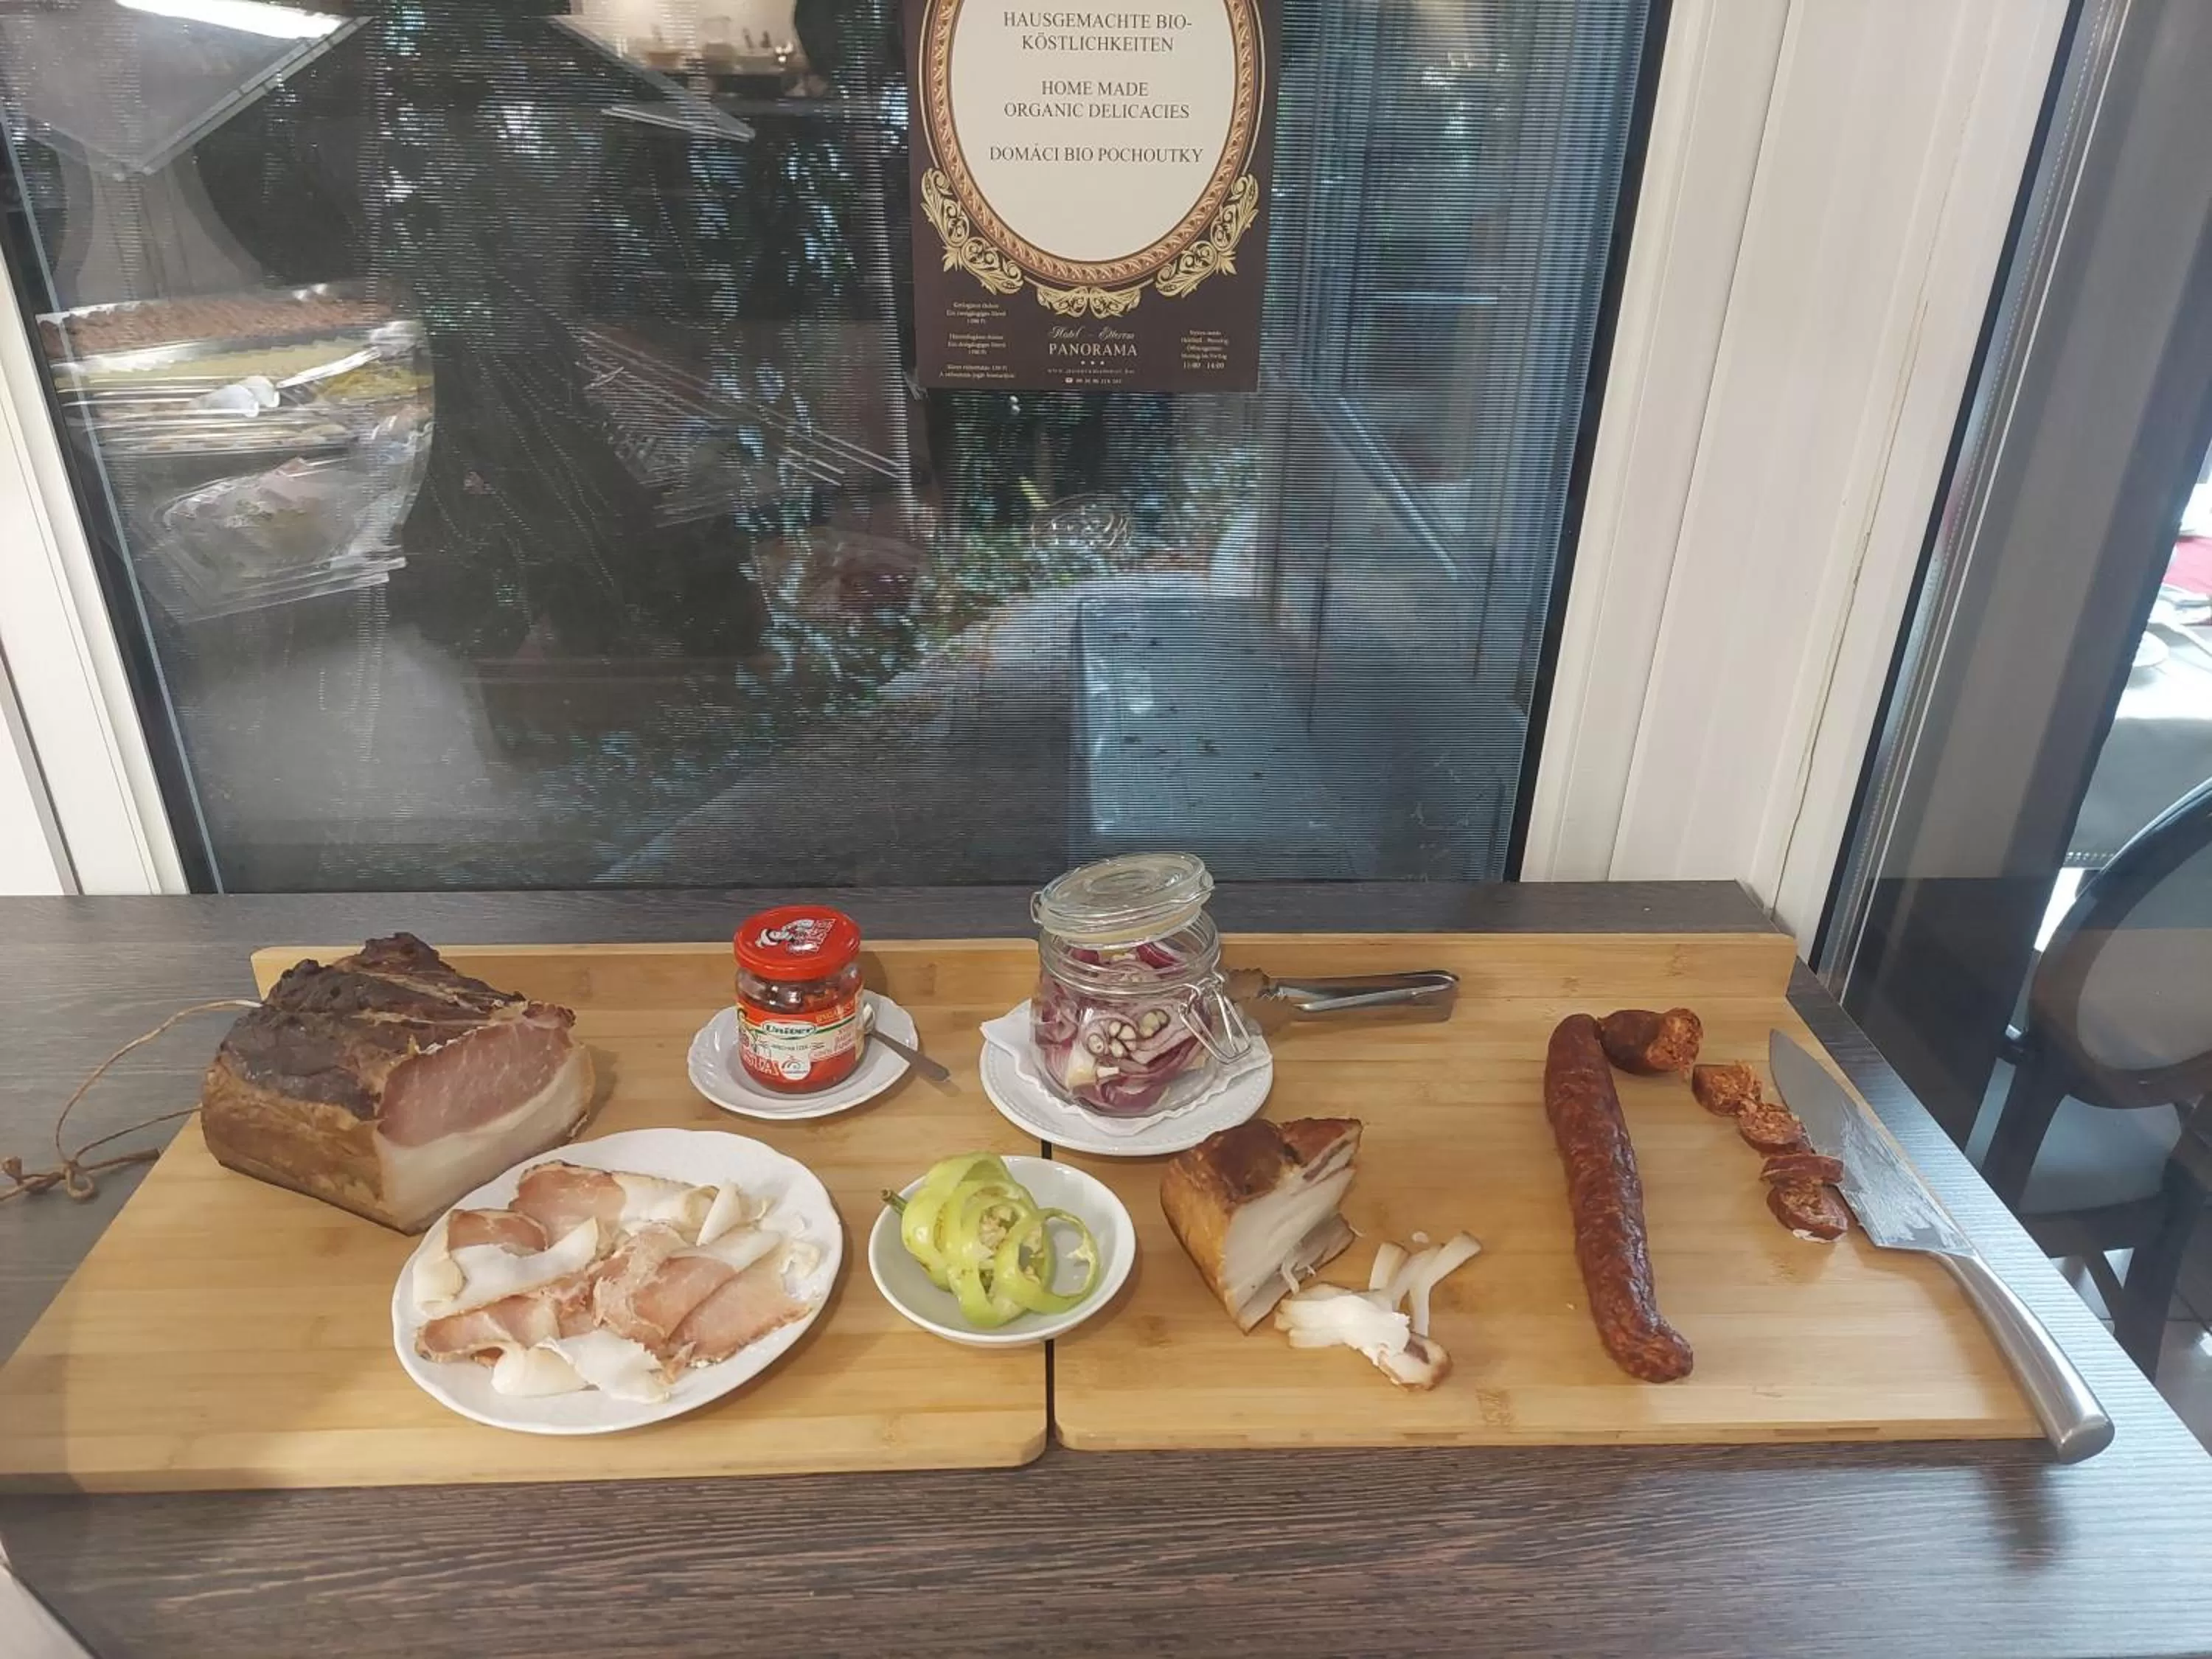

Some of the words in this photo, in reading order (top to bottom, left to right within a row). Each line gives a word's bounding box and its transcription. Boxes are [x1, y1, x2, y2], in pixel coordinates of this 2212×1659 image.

[1004, 11, 1151, 29] HAUSGEMACHTE
[1156, 14, 1192, 30] BIO-
[1022, 32, 1174, 52] KÖSTLICHKEITEN
[1041, 80, 1093, 96] HOME
[1098, 81, 1149, 97] MADE
[1004, 102, 1084, 118] ORGANIC
[1088, 103, 1189, 119] DELICACIES
[1064, 147, 1094, 161] BIO
[1098, 147, 1204, 163] POCHOUTKY
[1049, 343, 1137, 355] PANORAMA
